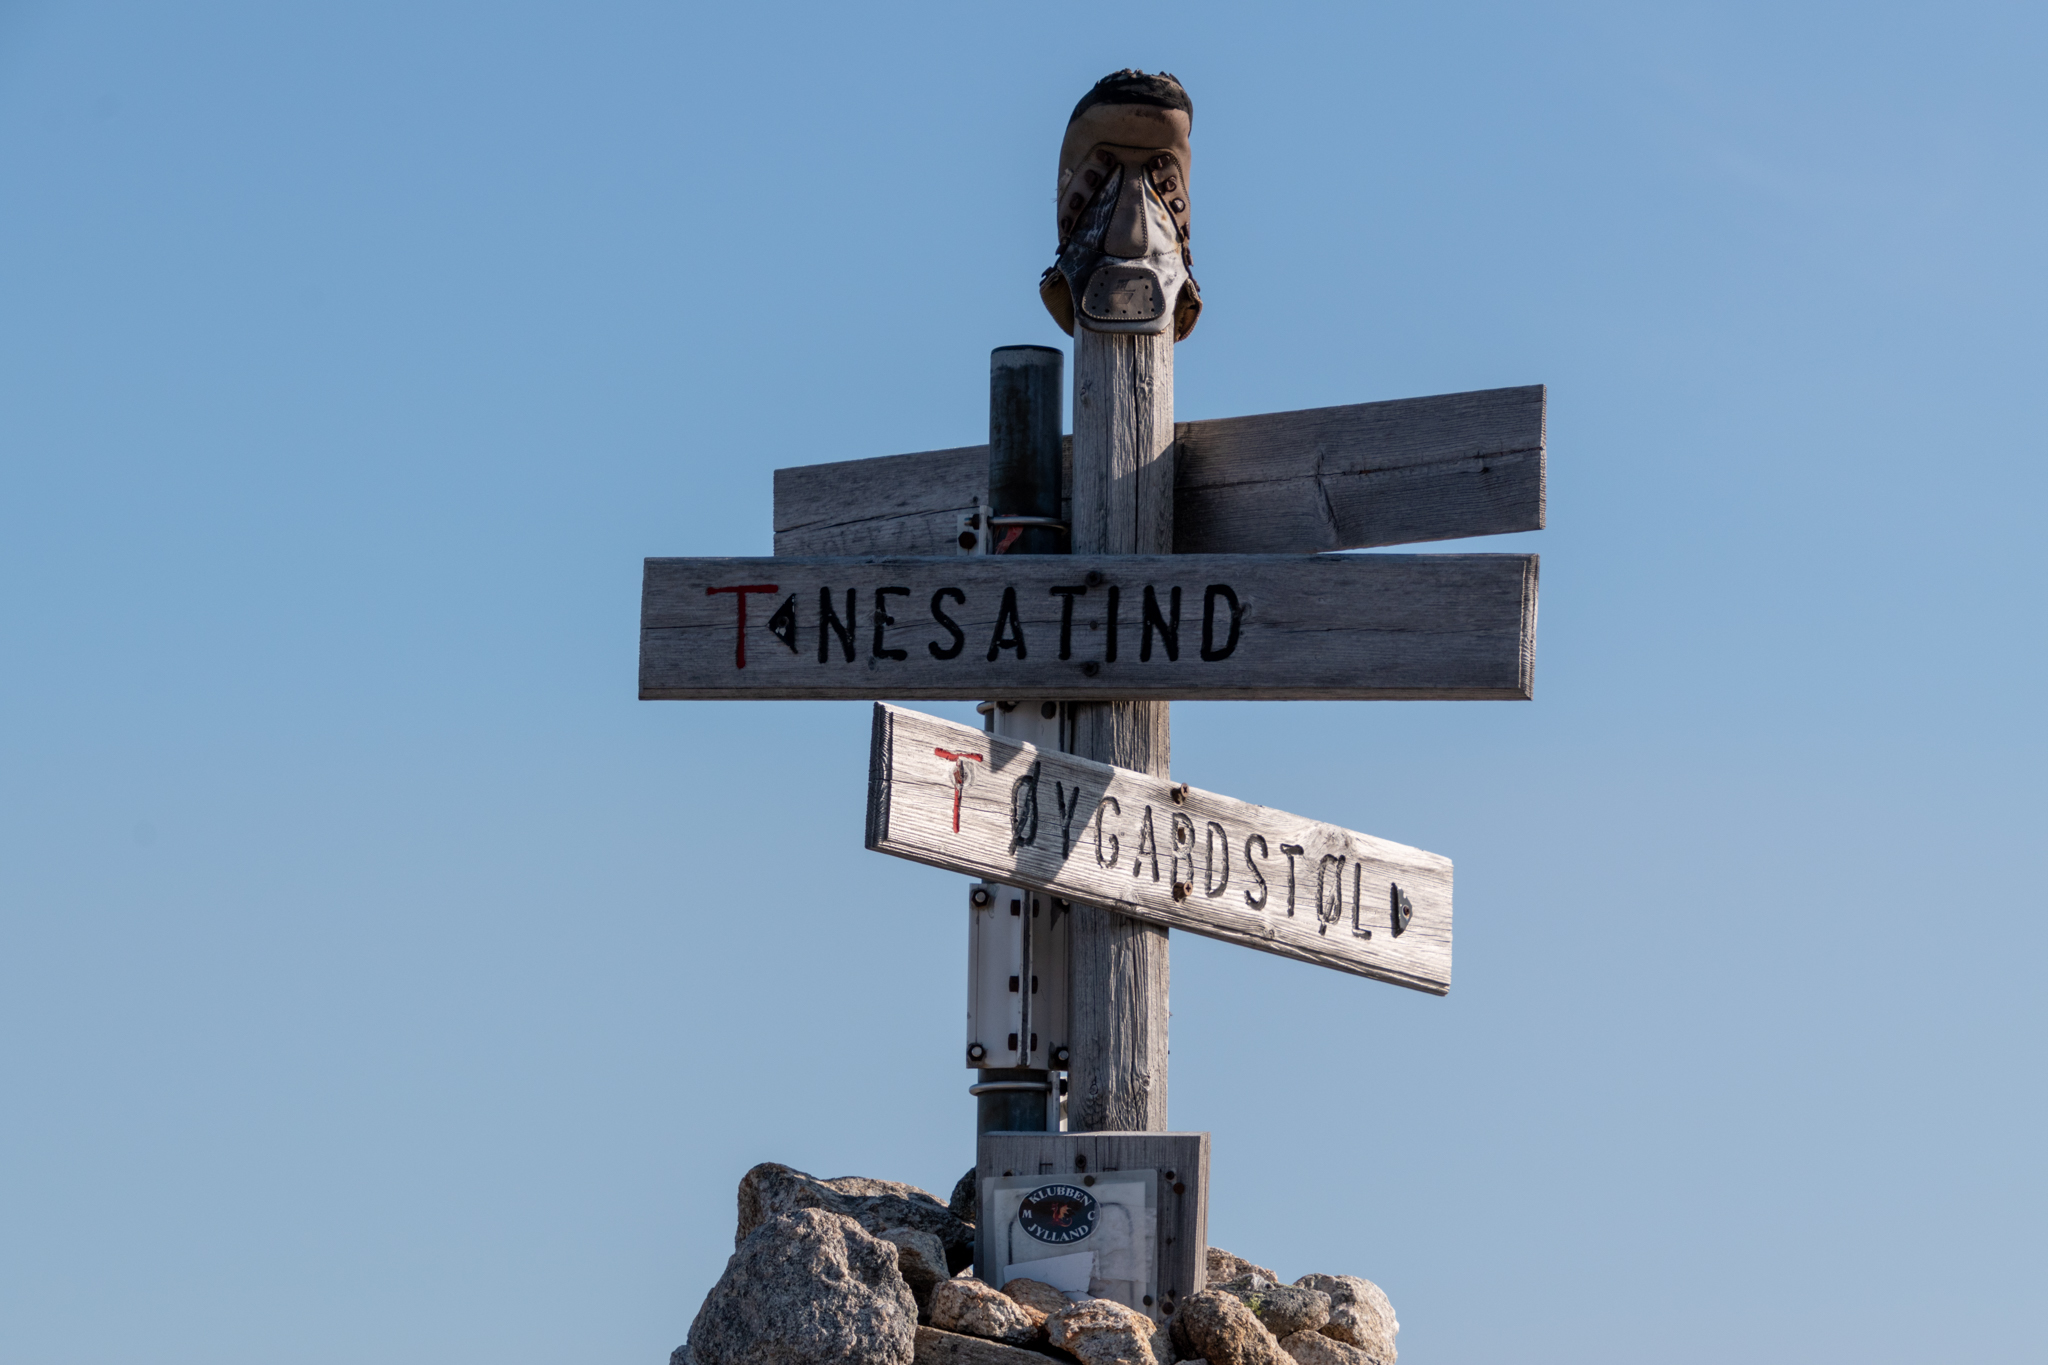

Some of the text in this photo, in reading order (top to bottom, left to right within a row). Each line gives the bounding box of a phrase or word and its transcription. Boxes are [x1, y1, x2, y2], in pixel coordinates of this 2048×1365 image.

[706, 584, 1242, 669] T NESATIND
[935, 747, 983, 833] T
[1028, 1186, 1093, 1207] KLUBBEN
[1022, 1209, 1096, 1221] M C
[1027, 1223, 1089, 1242] JYLLAND
